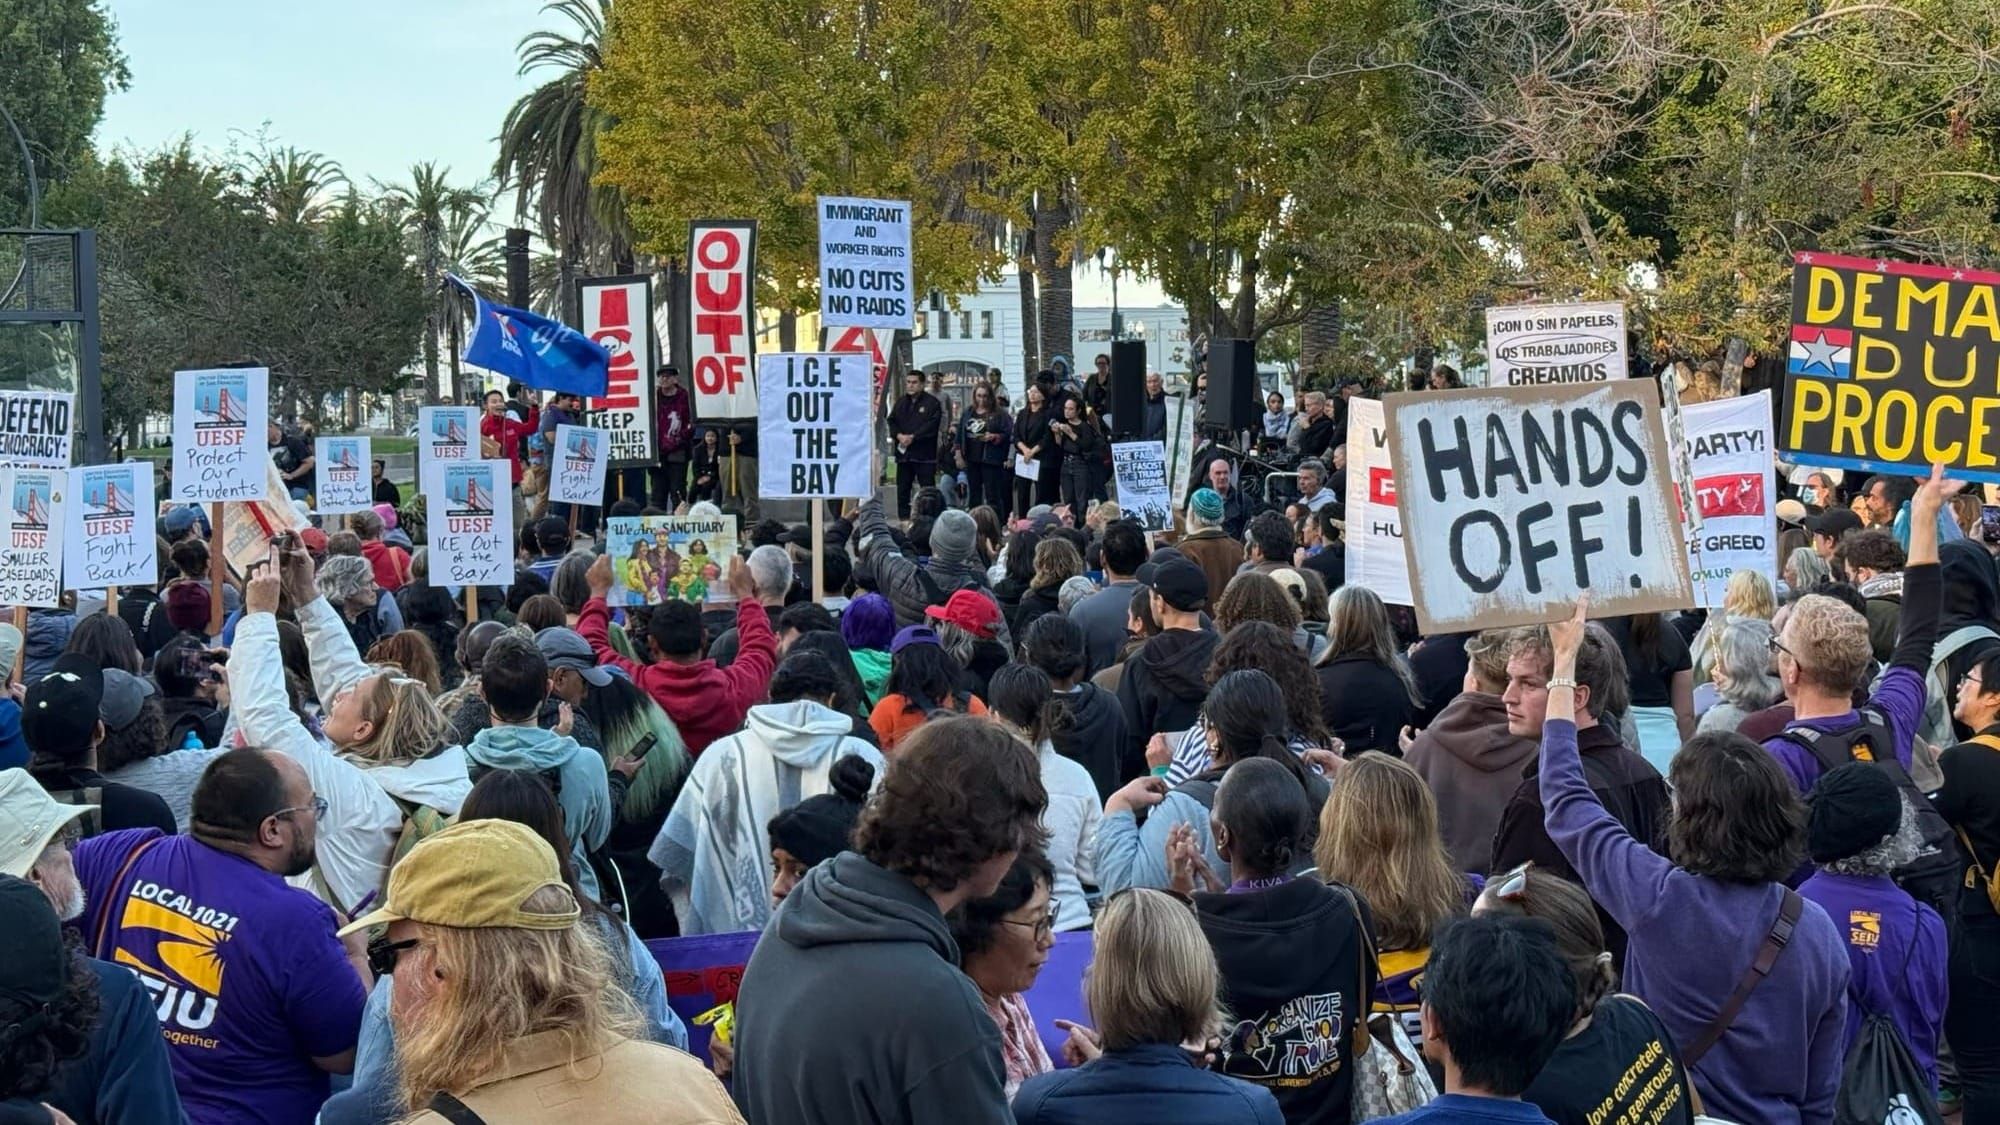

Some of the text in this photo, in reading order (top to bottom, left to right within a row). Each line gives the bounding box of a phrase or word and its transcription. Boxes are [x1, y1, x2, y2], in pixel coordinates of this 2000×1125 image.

[826, 205, 903, 223] IMMIGRANT
[855, 225, 876, 238] AND
[826, 243, 904, 257] WORKER RIGHTS
[828, 268, 905, 291] NO CUTS
[828, 295, 905, 316] NO RAIDS
[1806, 267, 2000, 342] DEMA
[1493, 315, 1618, 335] ¡CON O SIN PAPELES,
[1496, 341, 1618, 359] LOS TRABAJADORES
[787, 357, 841, 388] I.C.E
[1856, 334, 2000, 394] DU
[695, 355, 745, 395] OF
[1508, 363, 1607, 386] CREAMOS
[787, 392, 833, 423] OUT
[590, 412, 634, 430] KEEP
[1790, 379, 2000, 468] PROCE
[0, 433, 67, 458] EMOCRACY:
[196, 430, 246, 446] UESF
[610, 430, 645, 445] ILIES
[793, 428, 839, 459] THE
[1686, 430, 1764, 460] ARTY!
[186, 447, 247, 468] Protect
[434, 447, 467, 458] UESF
[608, 444, 646, 460] ETHER
[1418, 400, 1648, 502] HANDS
[201, 467, 237, 481] Our
[566, 461, 594, 472] UESF
[330, 472, 359, 481] UESF
[560, 470, 593, 488] Fight
[791, 464, 840, 494] BAY
[182, 479, 259, 499] Students
[85, 520, 133, 537] UESF
[448, 518, 493, 533] UESF
[663, 521, 725, 534] SANCTUARY
[12, 532, 47, 549] UESF
[84, 535, 136, 564] Fight
[438, 535, 502, 551] ICE Out
[1705, 534, 1765, 551] GREED
[453, 552, 493, 564] of the
[1249, 877, 1283, 889] KIVA
[131, 879, 239, 932] LOCAL 1021
[1851, 931, 1880, 944] SEIU
[162, 1028, 219, 1049] ogether
[1586, 1096, 1614, 1125] love
[1649, 1083, 1680, 1125] justice
